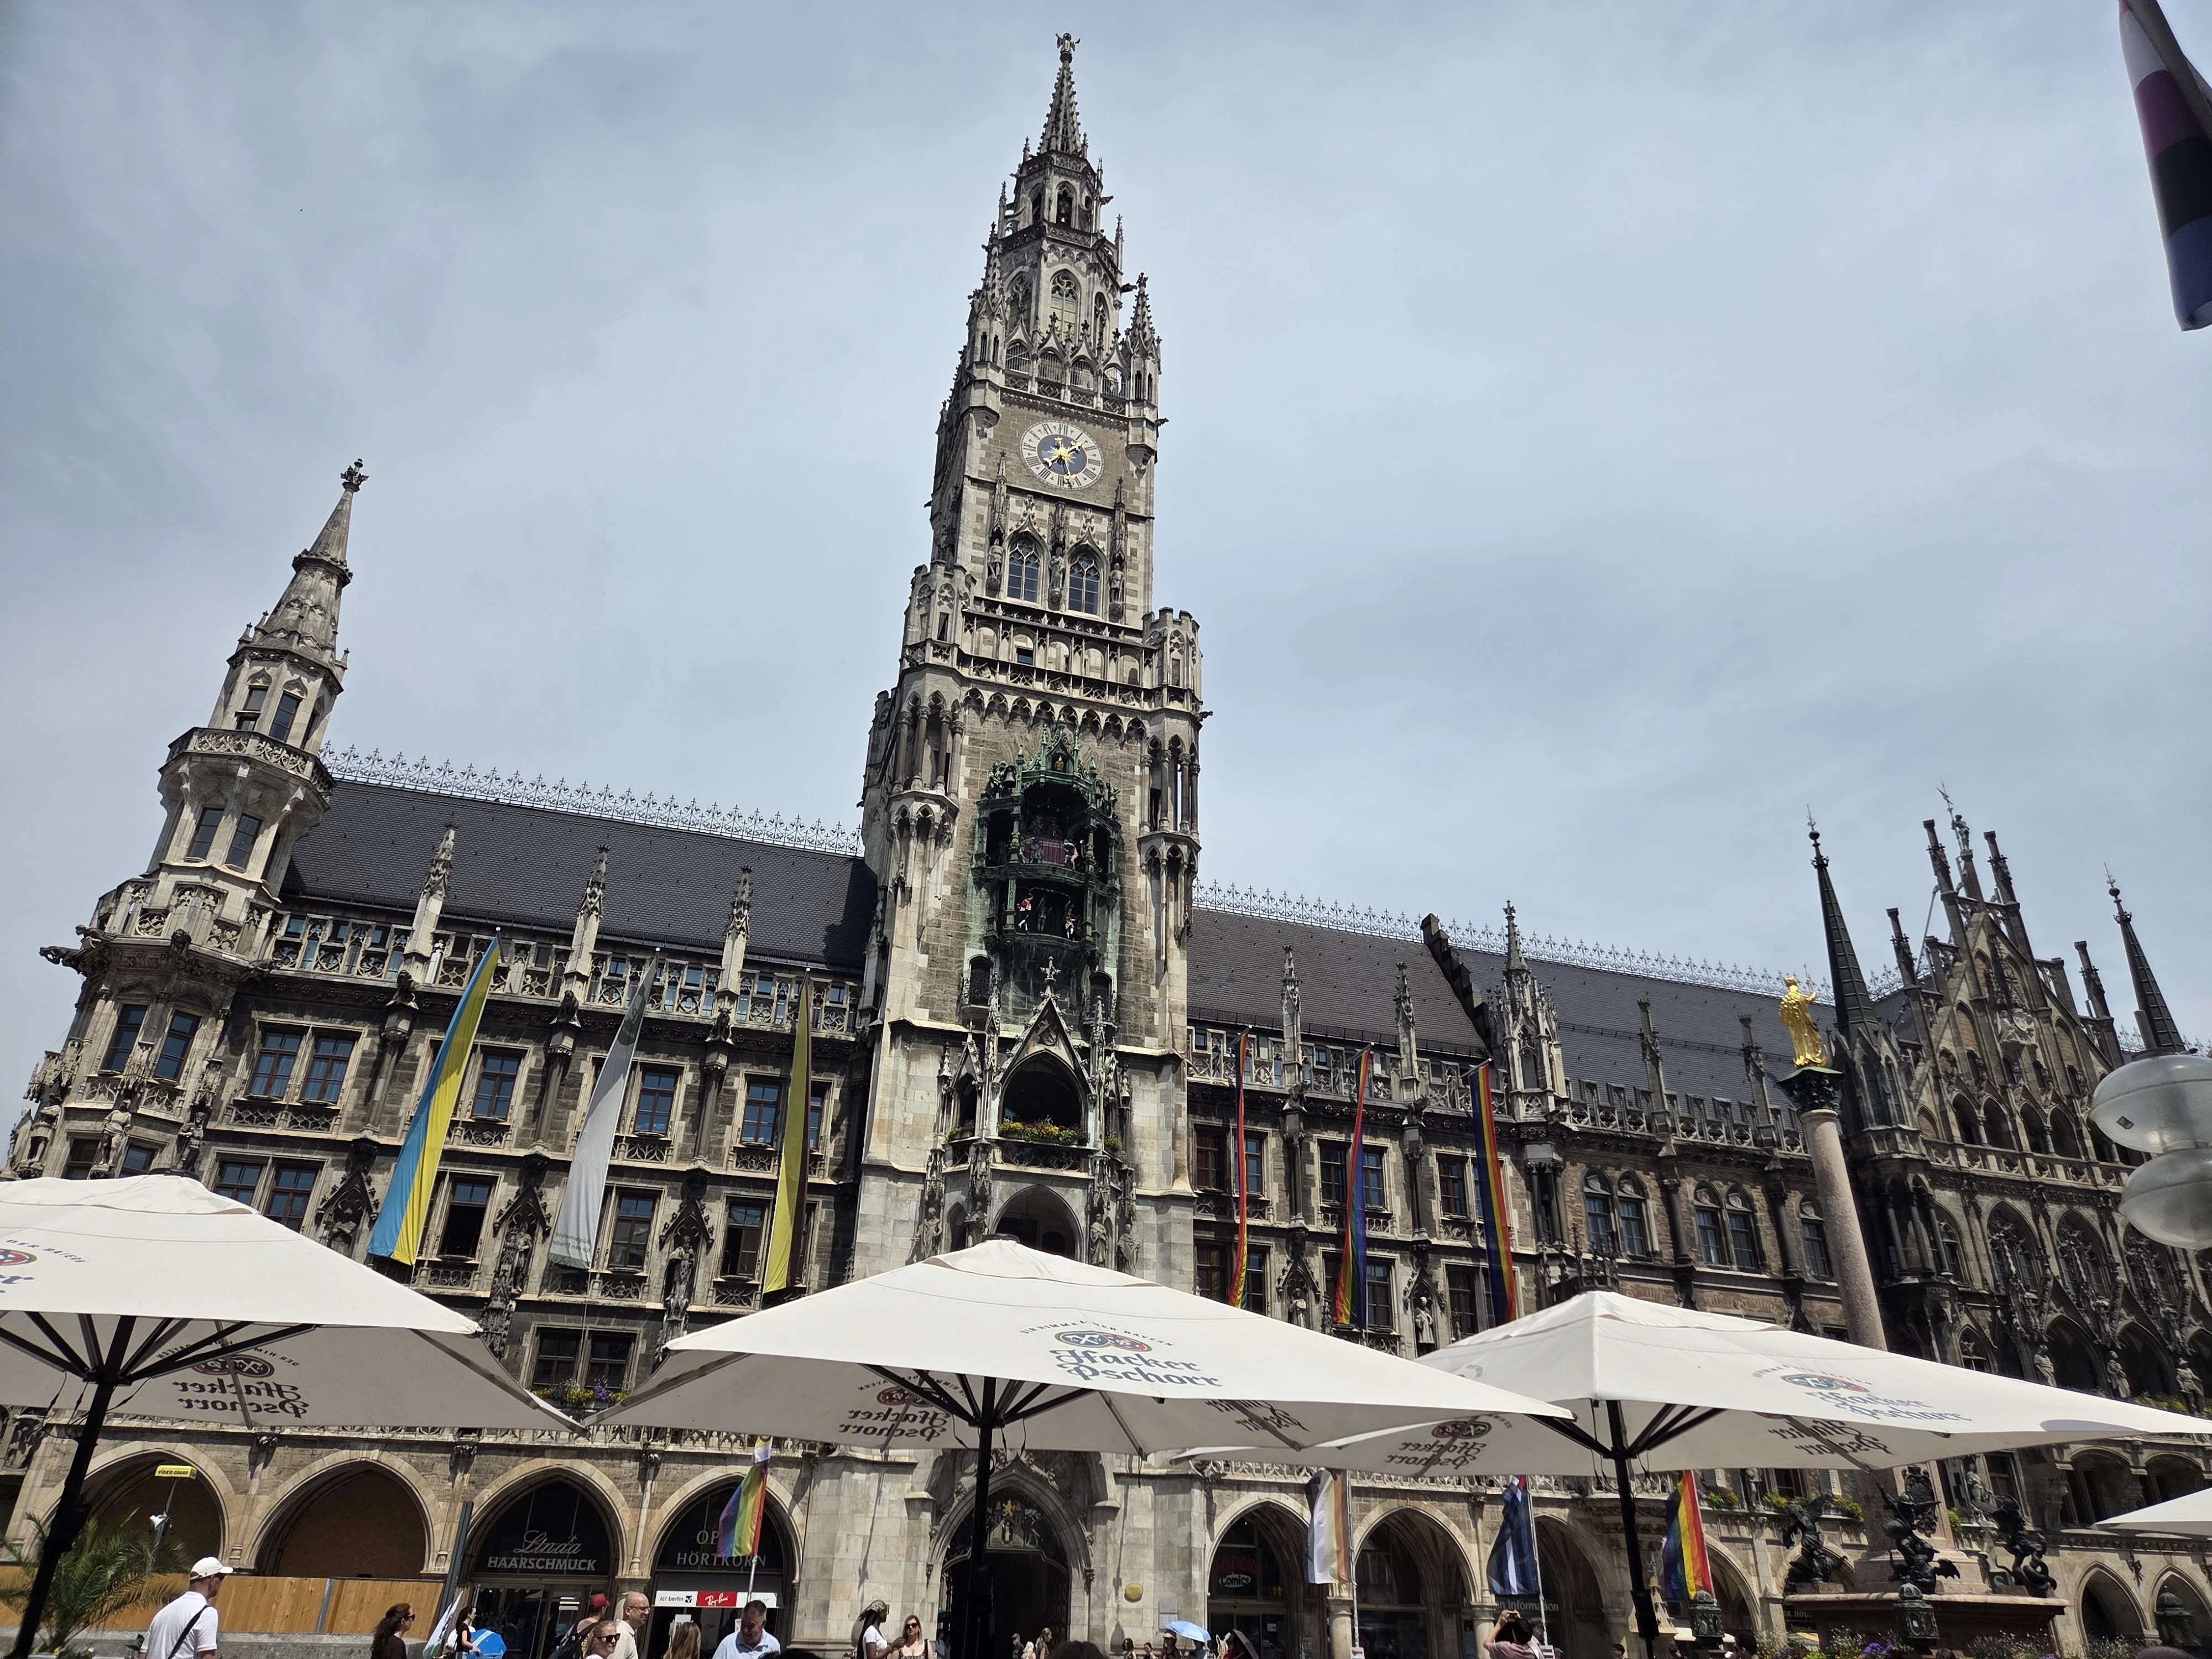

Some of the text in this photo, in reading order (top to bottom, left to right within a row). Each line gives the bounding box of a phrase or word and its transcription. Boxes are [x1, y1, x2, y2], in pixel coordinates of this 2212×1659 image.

[1040, 1319, 1086, 1330] HIMMEL
[1124, 1330, 1174, 1347] BAYERN
[1048, 1349, 1202, 1371] Hacker
[1056, 1363, 1223, 1386] Pschorr
[513, 1530, 582, 1554] Linda
[487, 1556, 597, 1571] HAARSCHMUCK
[676, 1551, 766, 1568] HÖRTKORN
[1220, 1574, 1250, 1586] Comics
